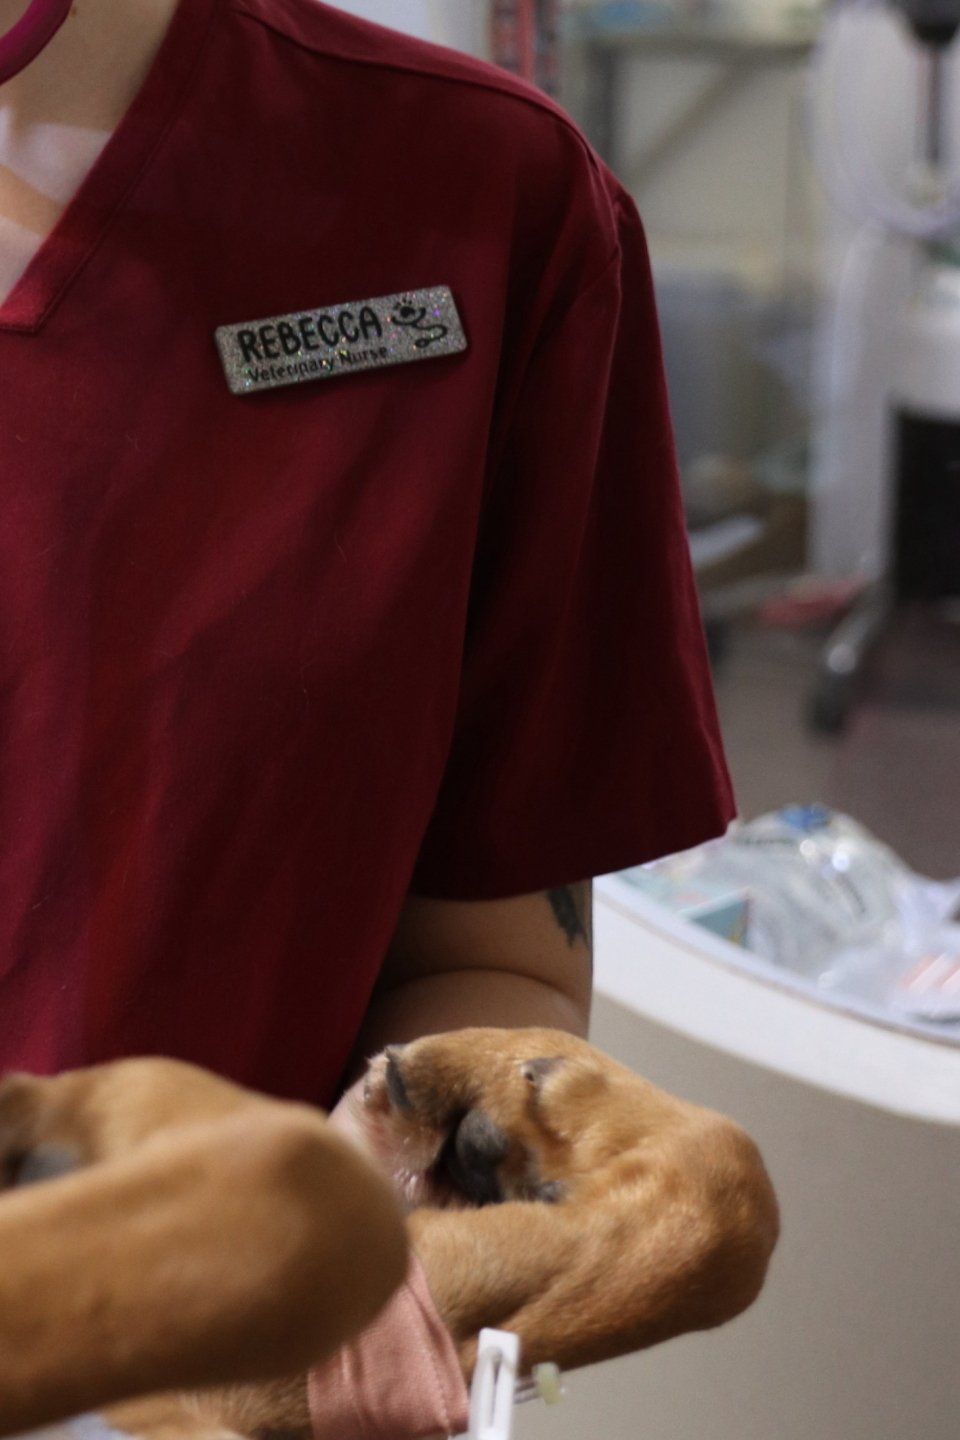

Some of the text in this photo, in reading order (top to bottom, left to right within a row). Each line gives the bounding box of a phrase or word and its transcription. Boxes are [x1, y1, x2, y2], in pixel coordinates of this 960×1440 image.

[237, 306, 383, 363] REBECCA
[248, 346, 388, 383] Veterinary Nurse
